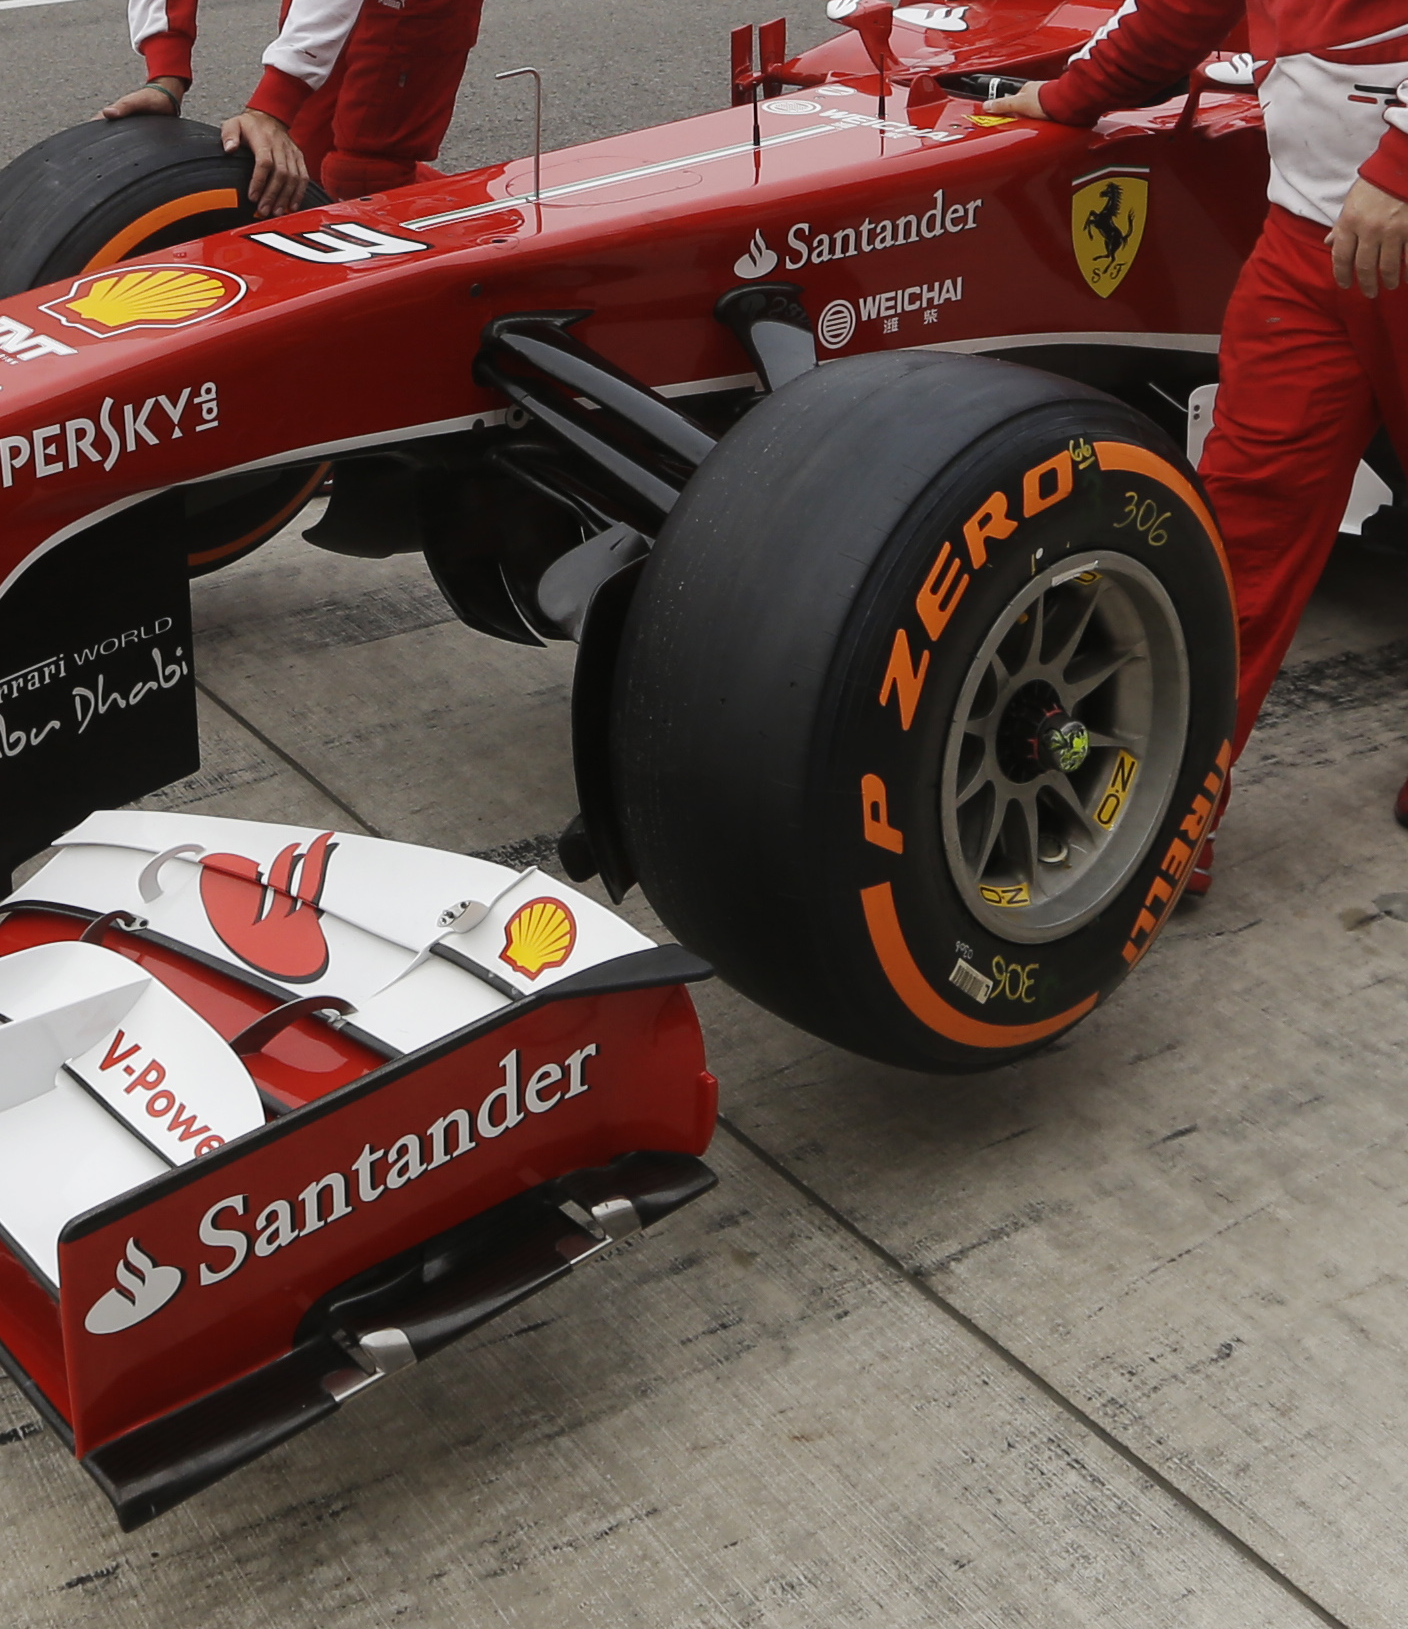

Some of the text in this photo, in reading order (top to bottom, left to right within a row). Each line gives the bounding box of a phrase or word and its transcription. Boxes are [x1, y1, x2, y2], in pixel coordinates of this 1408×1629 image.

[818, 108, 965, 142] WEICHAI
[246, 221, 434, 265] 3
[785, 188, 984, 270] Santander
[858, 276, 963, 322] WEICHAI
[193, 380, 220, 433] lab
[1112, 491, 1172, 547] 306
[73, 617, 173, 666] WORLD
[861, 449, 1074, 855] P ZERO
[72, 646, 189, 735] Dhabi
[98, 1028, 226, 1159] V-Powe
[199, 1041, 599, 1288] Santander
